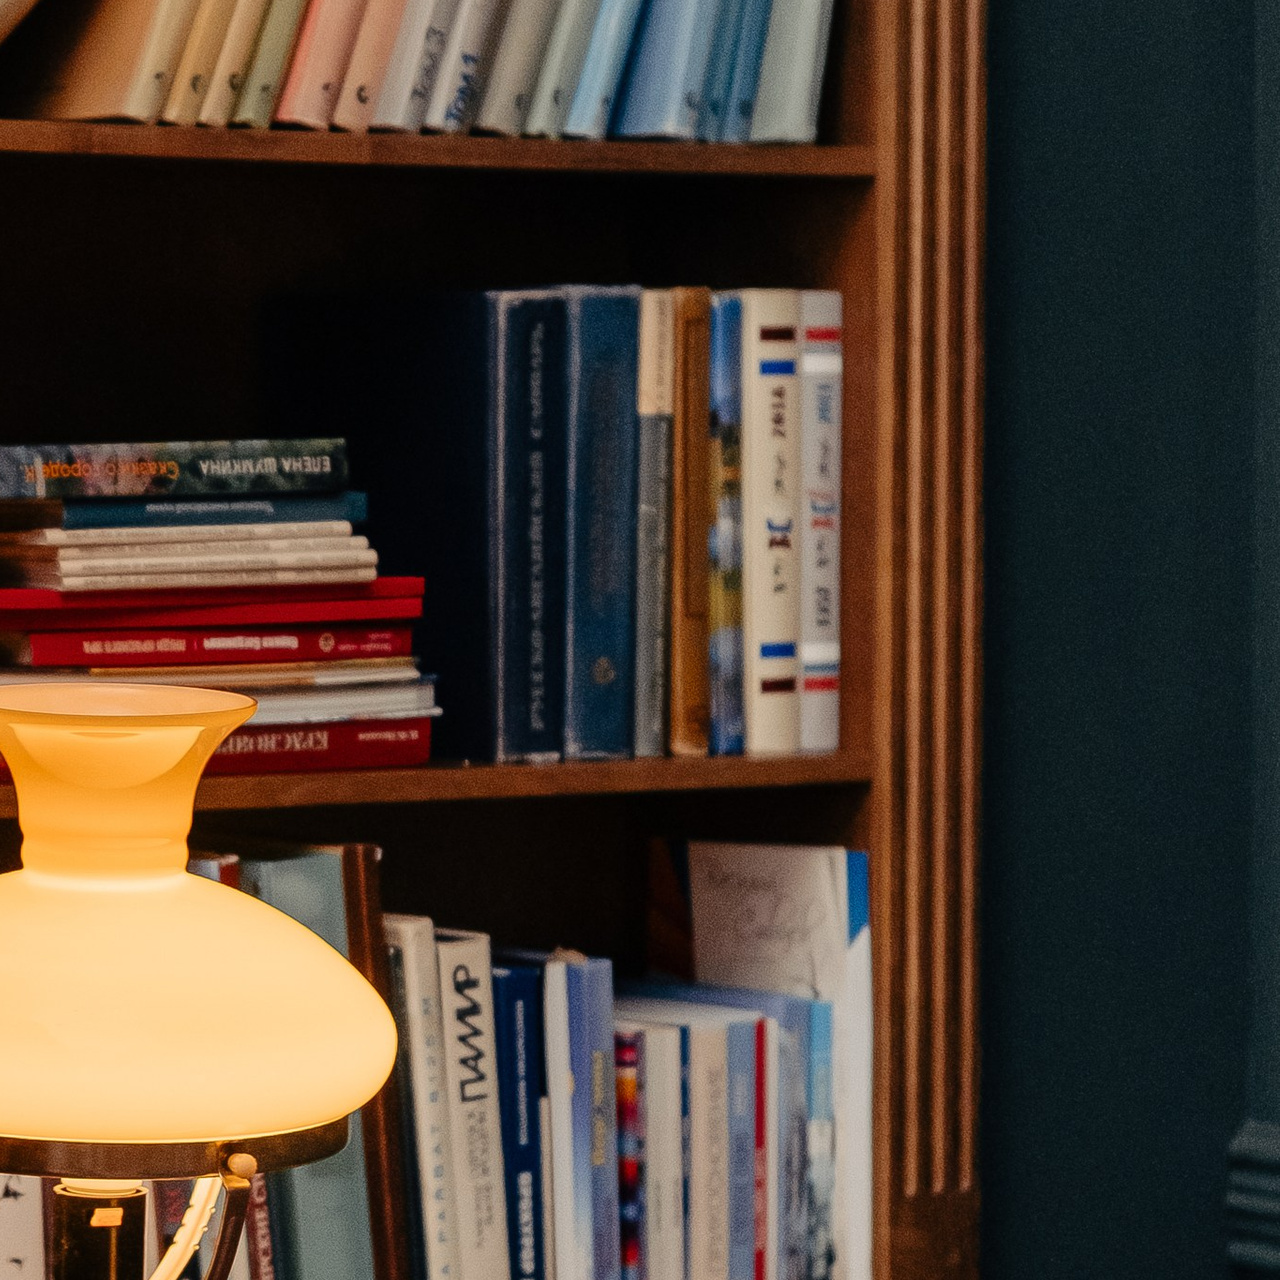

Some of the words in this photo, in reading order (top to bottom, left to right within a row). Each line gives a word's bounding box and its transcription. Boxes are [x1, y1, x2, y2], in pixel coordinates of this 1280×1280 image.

[198, 456, 276, 477] ШУМКИНА
[281, 454, 331, 474] ЕЛЕНА
[452, 963, 489, 1104] ПАМИР
[434, 1123, 453, 1241] PARBAT
